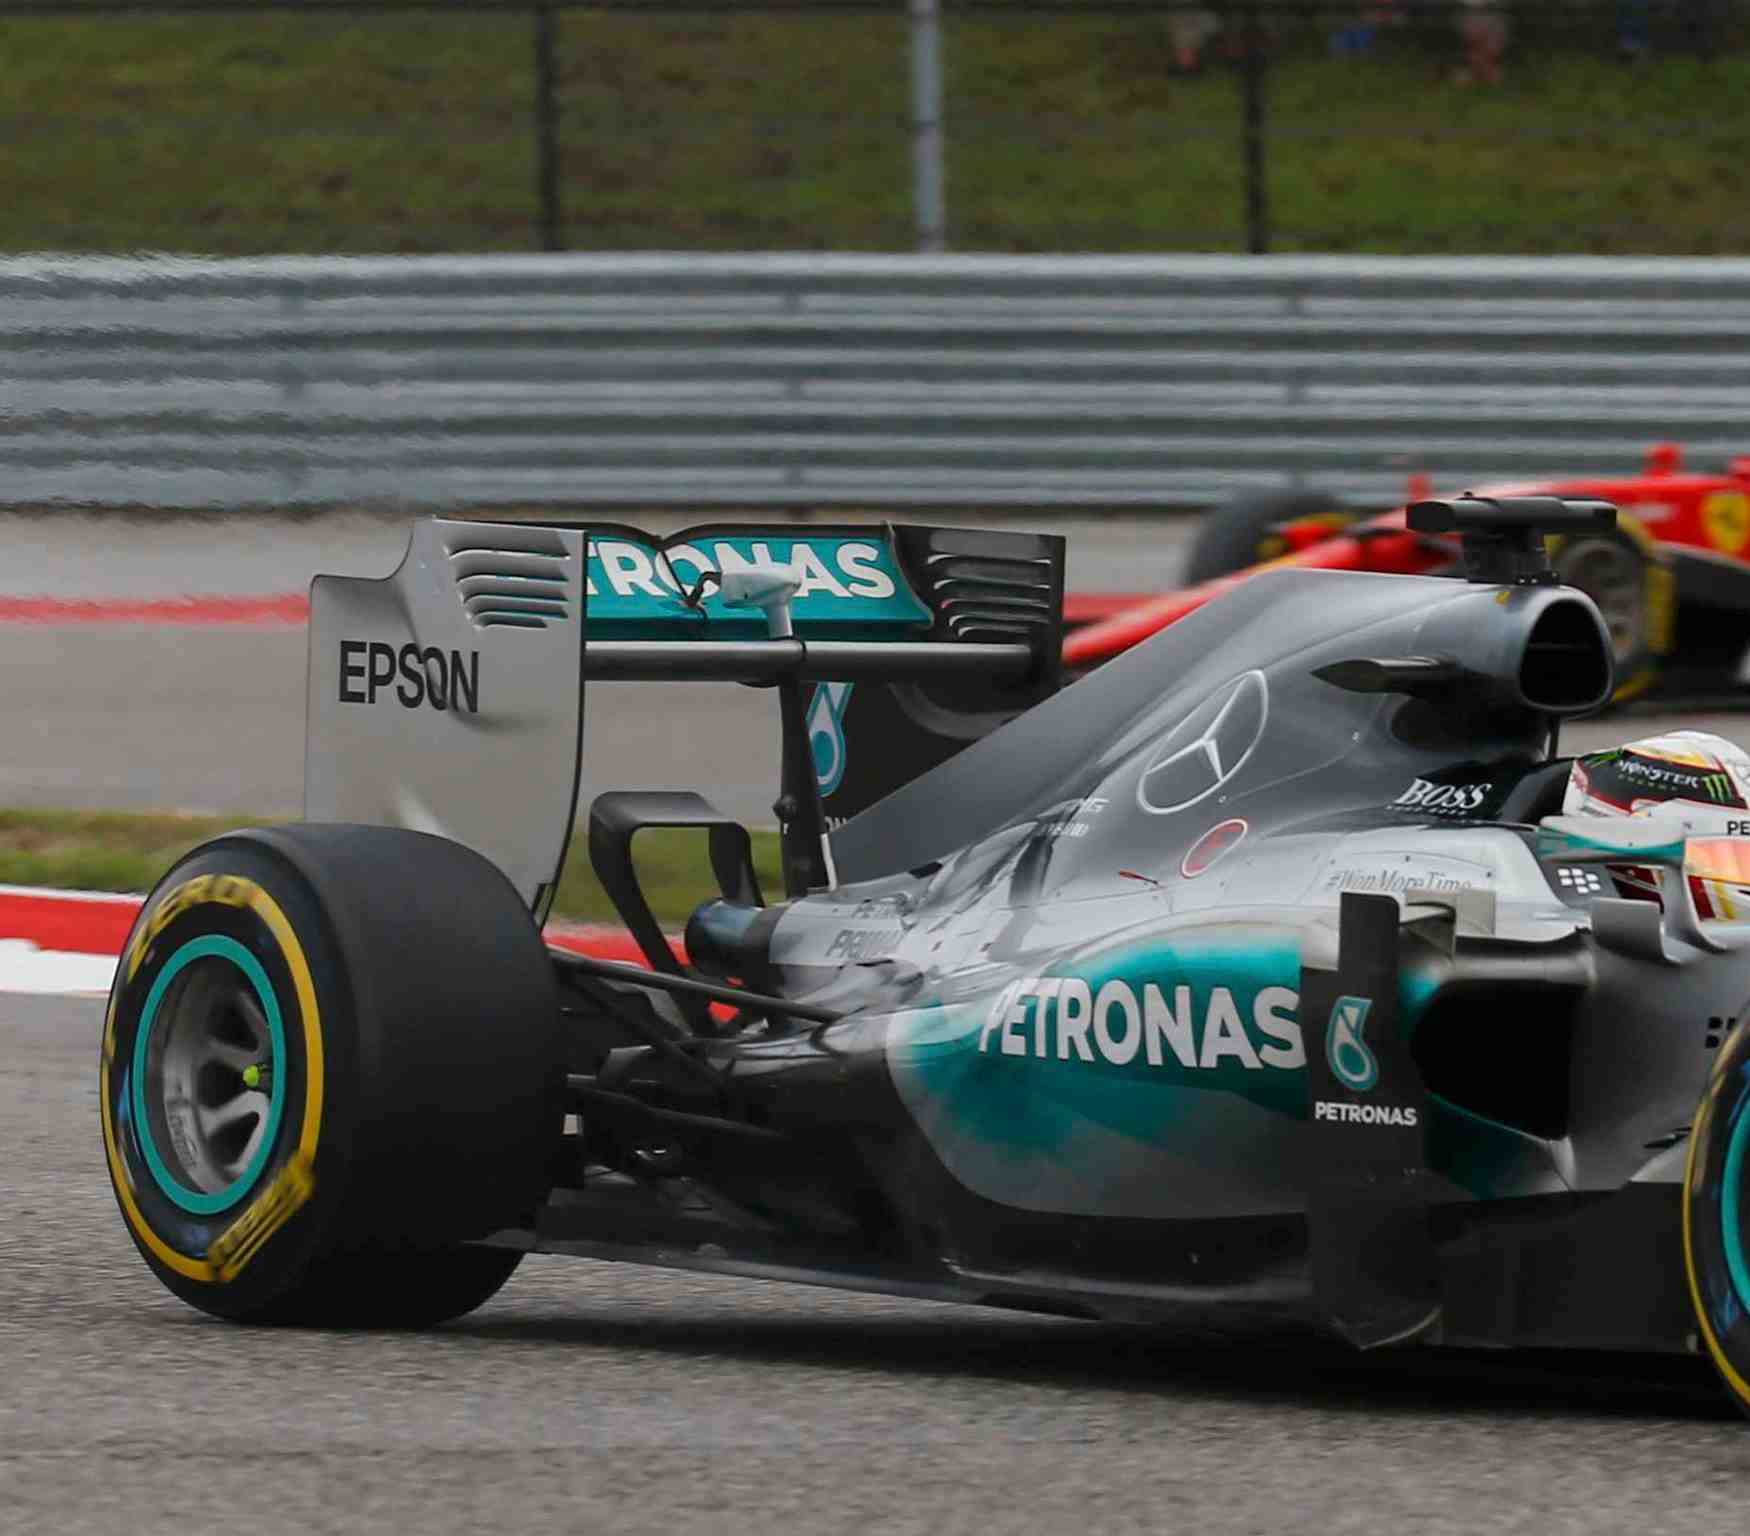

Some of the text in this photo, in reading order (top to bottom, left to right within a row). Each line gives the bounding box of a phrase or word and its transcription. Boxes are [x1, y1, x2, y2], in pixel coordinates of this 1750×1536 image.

[339, 640, 479, 713] EPSON
[1618, 759, 1699, 788] MONSTER
[1394, 776, 1493, 810] BOSS
[978, 976, 1307, 1070] PETRONAS
[1314, 1101, 1418, 1126] PETRONAS
